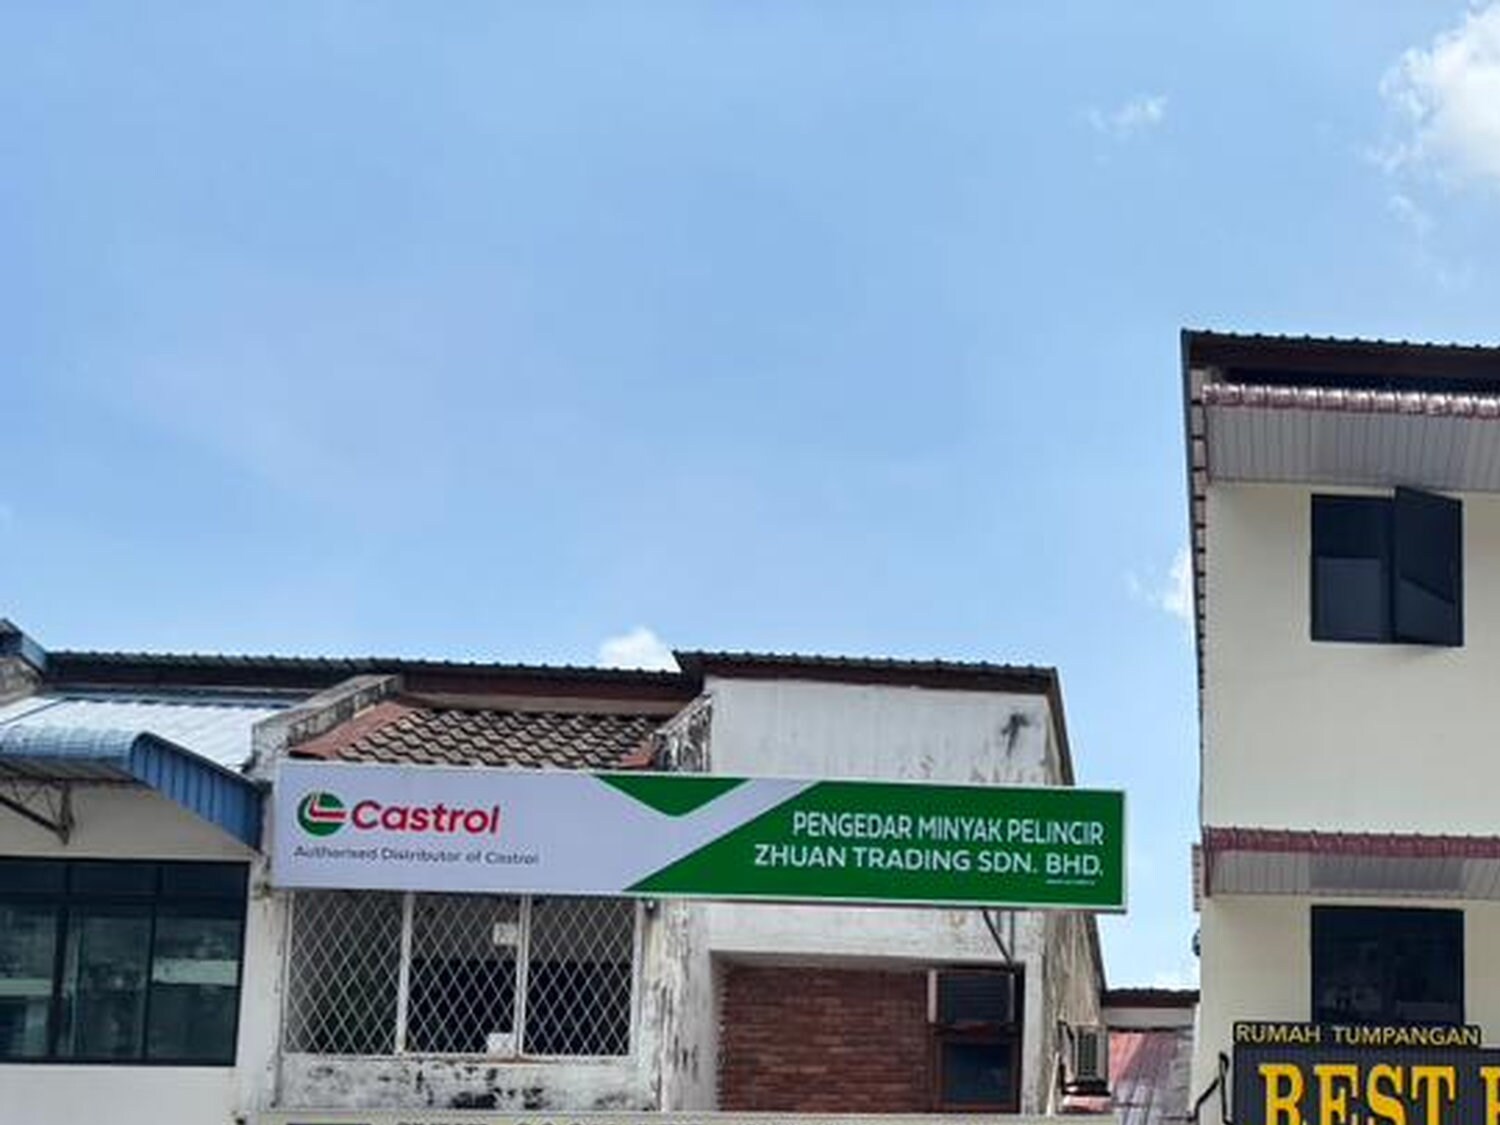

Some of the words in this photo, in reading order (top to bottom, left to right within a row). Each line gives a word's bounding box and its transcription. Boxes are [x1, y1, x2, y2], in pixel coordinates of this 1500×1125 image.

[351, 799, 499, 834] Castrol
[792, 811, 912, 840] PENGEDAR
[918, 815, 1002, 842] MINYAK
[1007, 818, 1104, 845] PELINCIR
[381, 847, 460, 863] Distributor
[466, 850, 481, 863] of
[485, 850, 539, 865] Castrol
[754, 843, 846, 868] ZHUAN
[852, 847, 971, 871] TRADING
[977, 850, 1038, 873] SDN.
[1046, 853, 1104, 876] BHD.
[1235, 1024, 1322, 1043] RUMAH
[1331, 1025, 1480, 1046] TUMPANGAN
